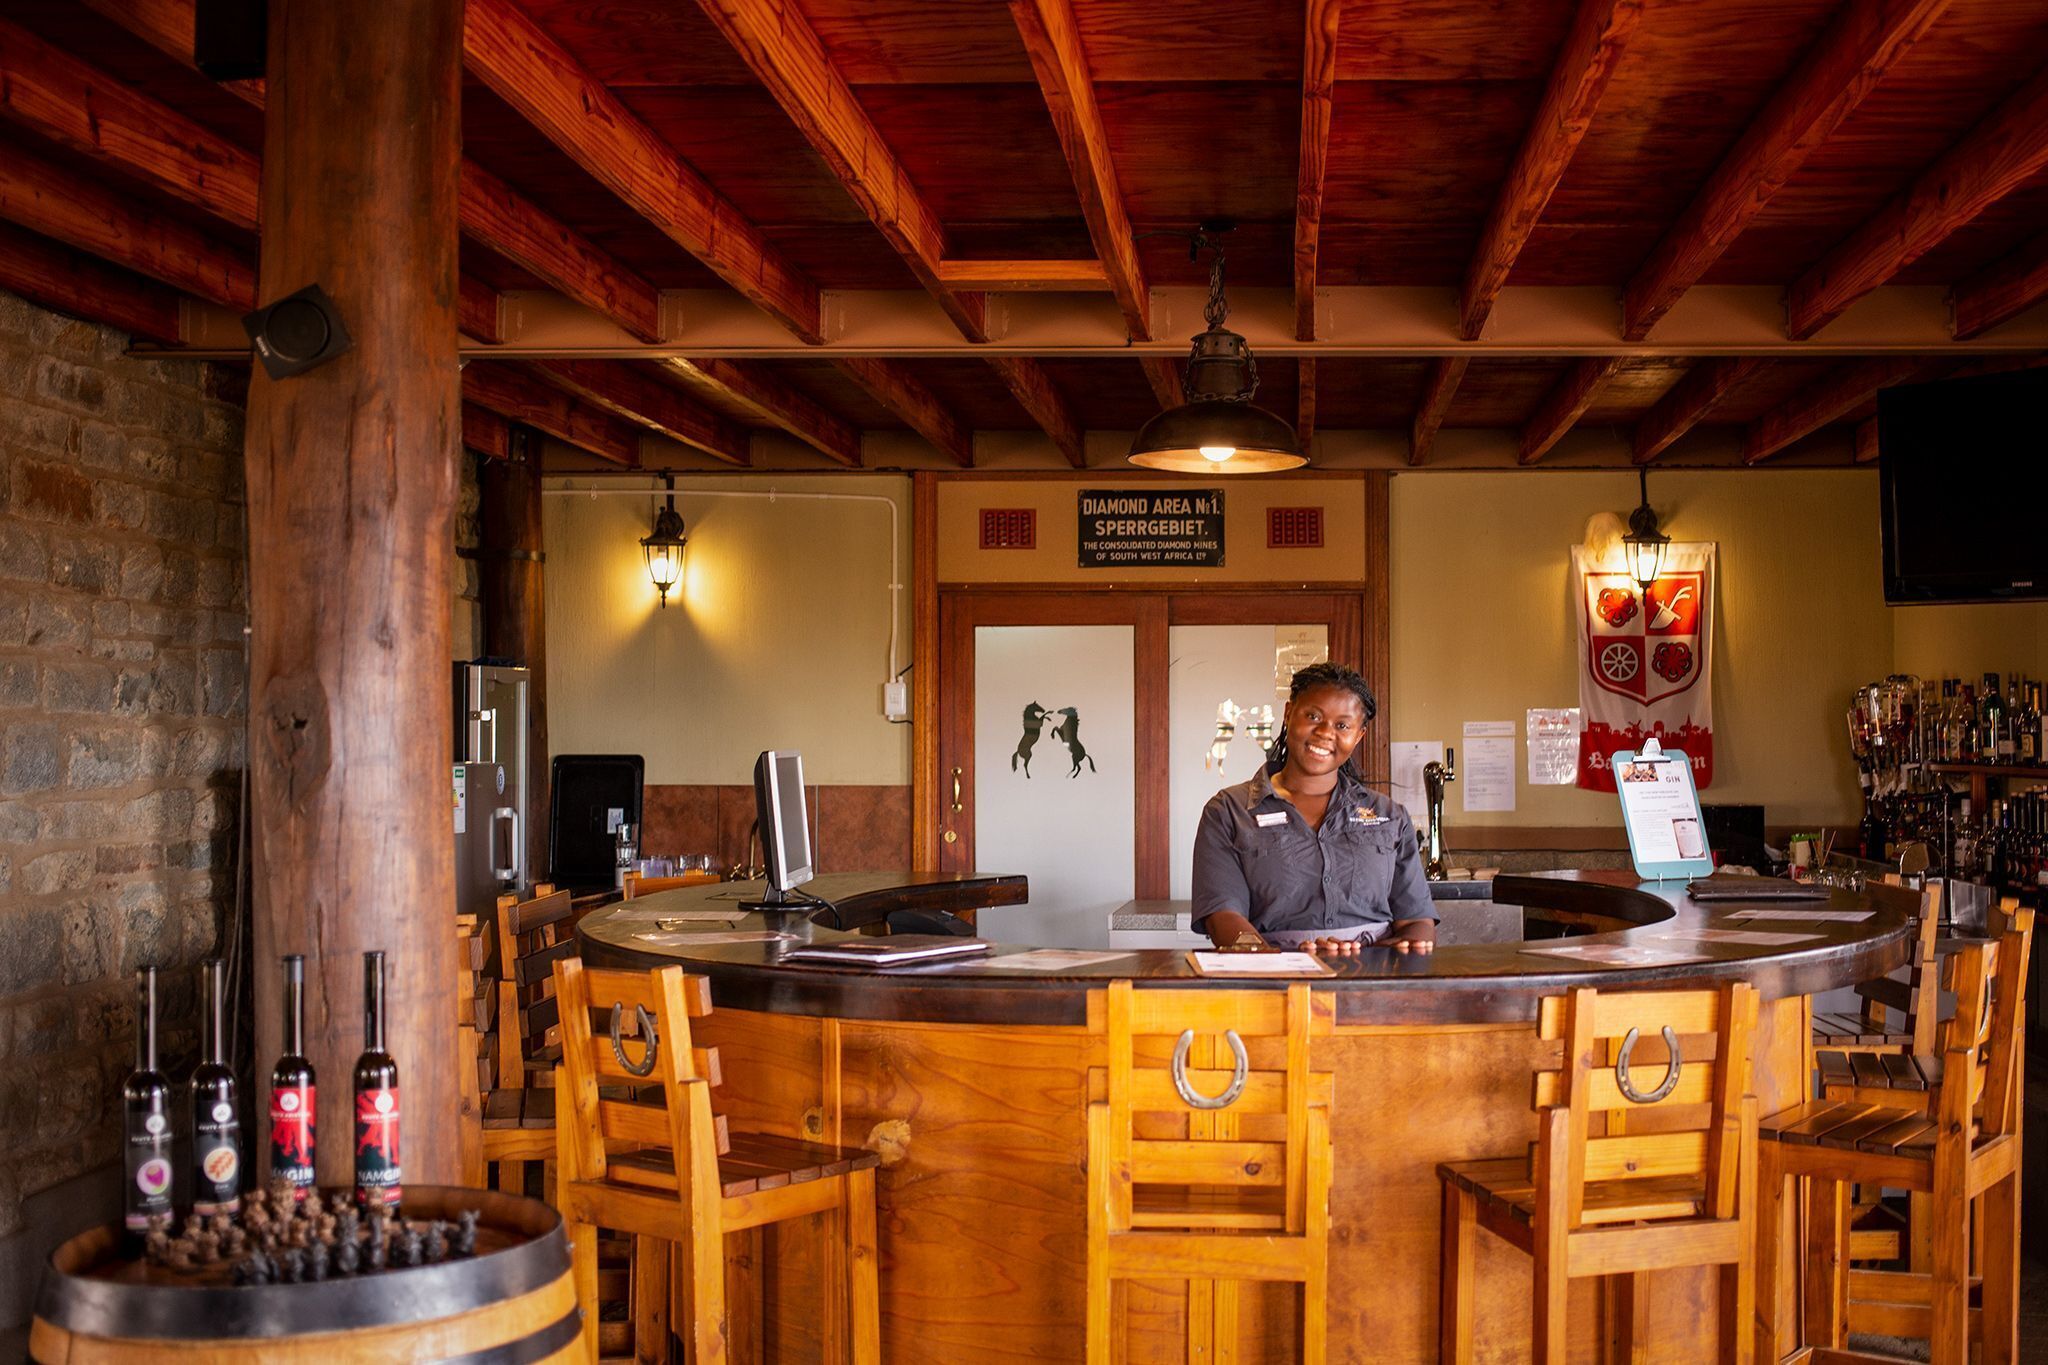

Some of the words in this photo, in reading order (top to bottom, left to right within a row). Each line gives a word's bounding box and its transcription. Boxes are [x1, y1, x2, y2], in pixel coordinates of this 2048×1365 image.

[1083, 498, 1147, 515] DIAMOND
[1152, 498, 1192, 515] AREA
[1095, 520, 1208, 536] SPERRGEBIET.
[1084, 542, 1098, 550] THE
[1099, 541, 1156, 550] CONSOLIDATED
[1157, 541, 1191, 549] DIAMOND
[1193, 540, 1217, 549] MINES
[1095, 552, 1107, 560] OF
[1110, 552, 1138, 560] SOUTH
[1140, 552, 1161, 560] WEST
[1164, 552, 1193, 560] AFRICA
